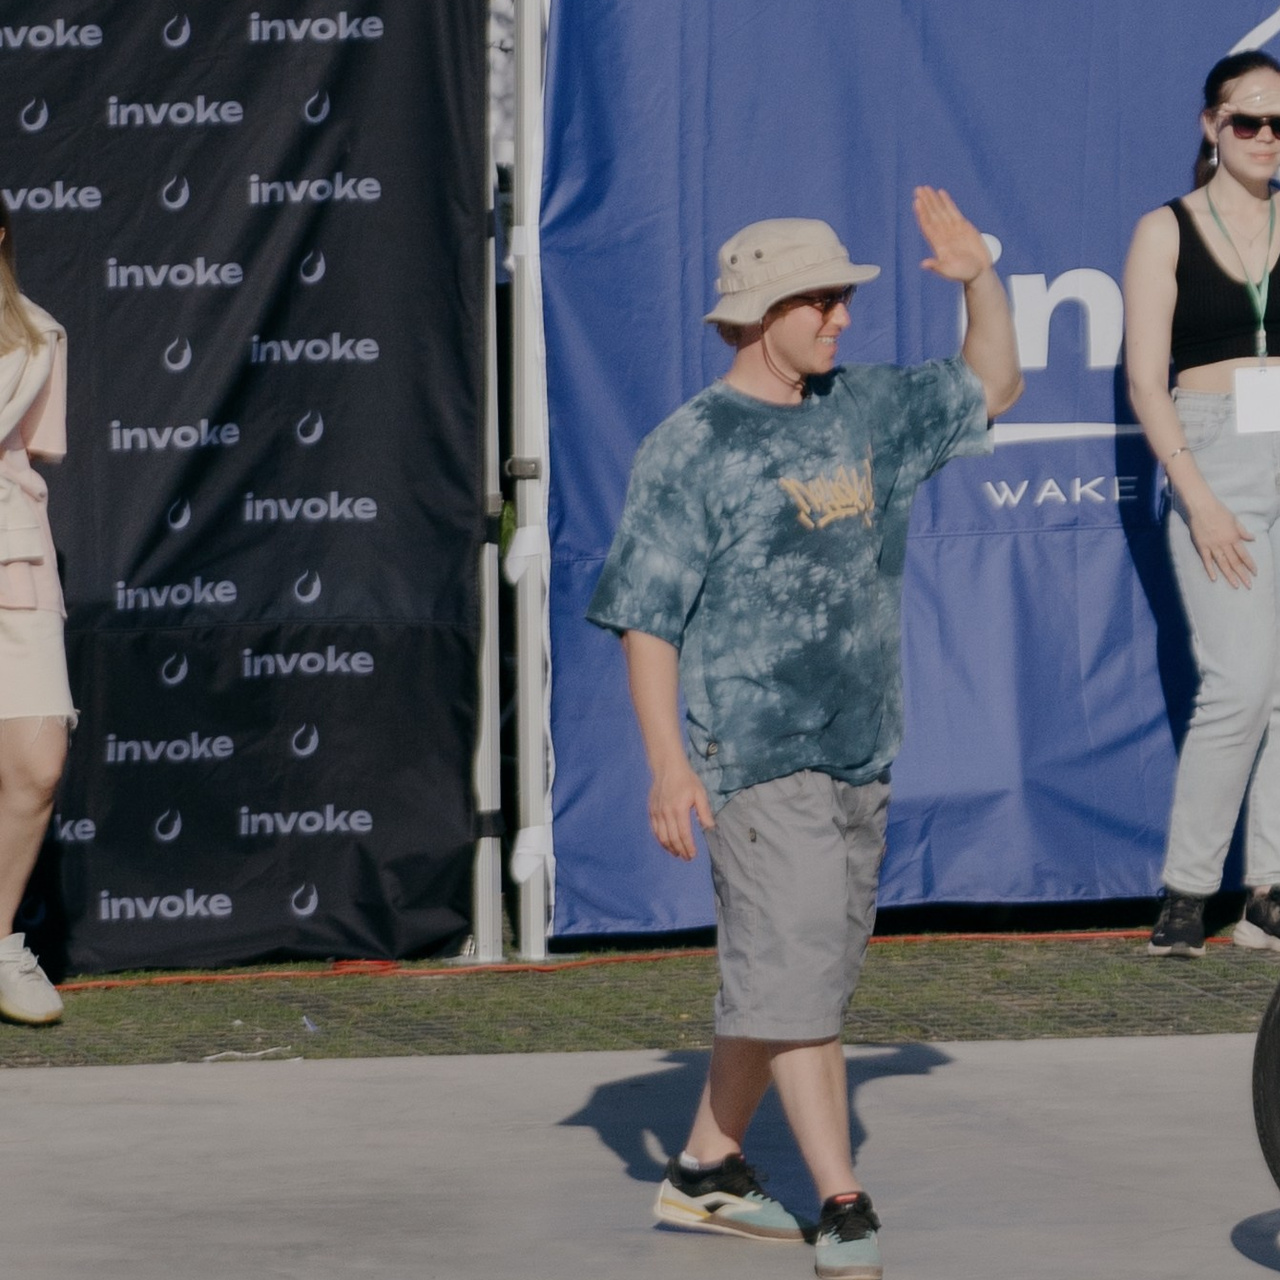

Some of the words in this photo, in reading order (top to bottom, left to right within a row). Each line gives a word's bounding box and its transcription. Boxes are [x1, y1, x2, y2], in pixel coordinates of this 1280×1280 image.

[0, 19, 103, 49] voke
[249, 11, 384, 43] invoke
[107, 95, 243, 126] invoke
[1, 180, 102, 211] voke
[248, 172, 382, 205] invoke
[106, 257, 243, 288] invoke
[250, 332, 380, 363] invoke
[109, 418, 240, 451] invoke
[244, 490, 378, 522] invoke
[985, 476, 1138, 507] WAKE
[114, 576, 238, 610] invoke
[242, 645, 374, 677] invoke
[105, 731, 234, 763] invoke
[240, 804, 373, 836] invoke
[99, 888, 233, 921] invoke
